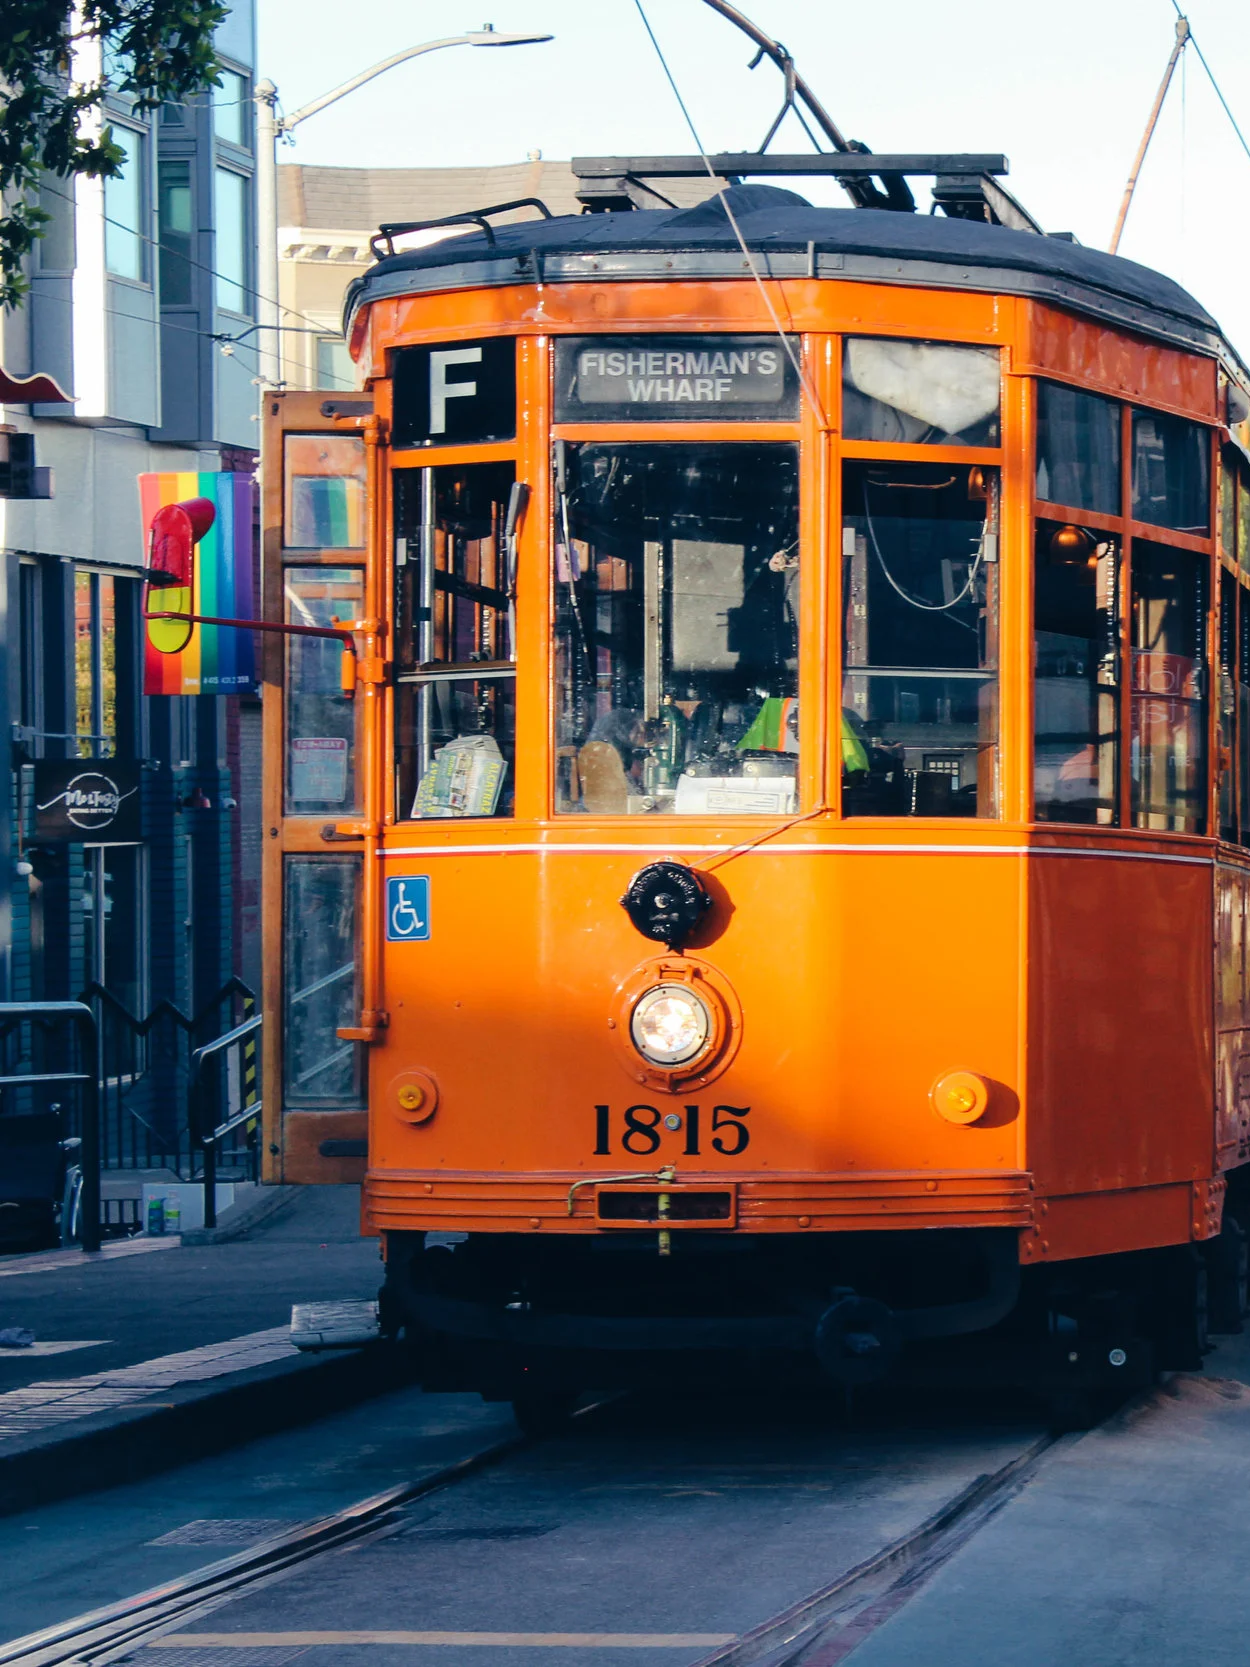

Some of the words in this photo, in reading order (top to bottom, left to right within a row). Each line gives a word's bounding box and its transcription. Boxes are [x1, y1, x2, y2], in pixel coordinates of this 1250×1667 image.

[581, 351, 777, 376] FISHERMAN'S
[429, 347, 483, 434] F
[628, 379, 732, 402] WHARF
[481, 762, 500, 814] ALCATRAZ
[593, 1105, 751, 1156] 1815
